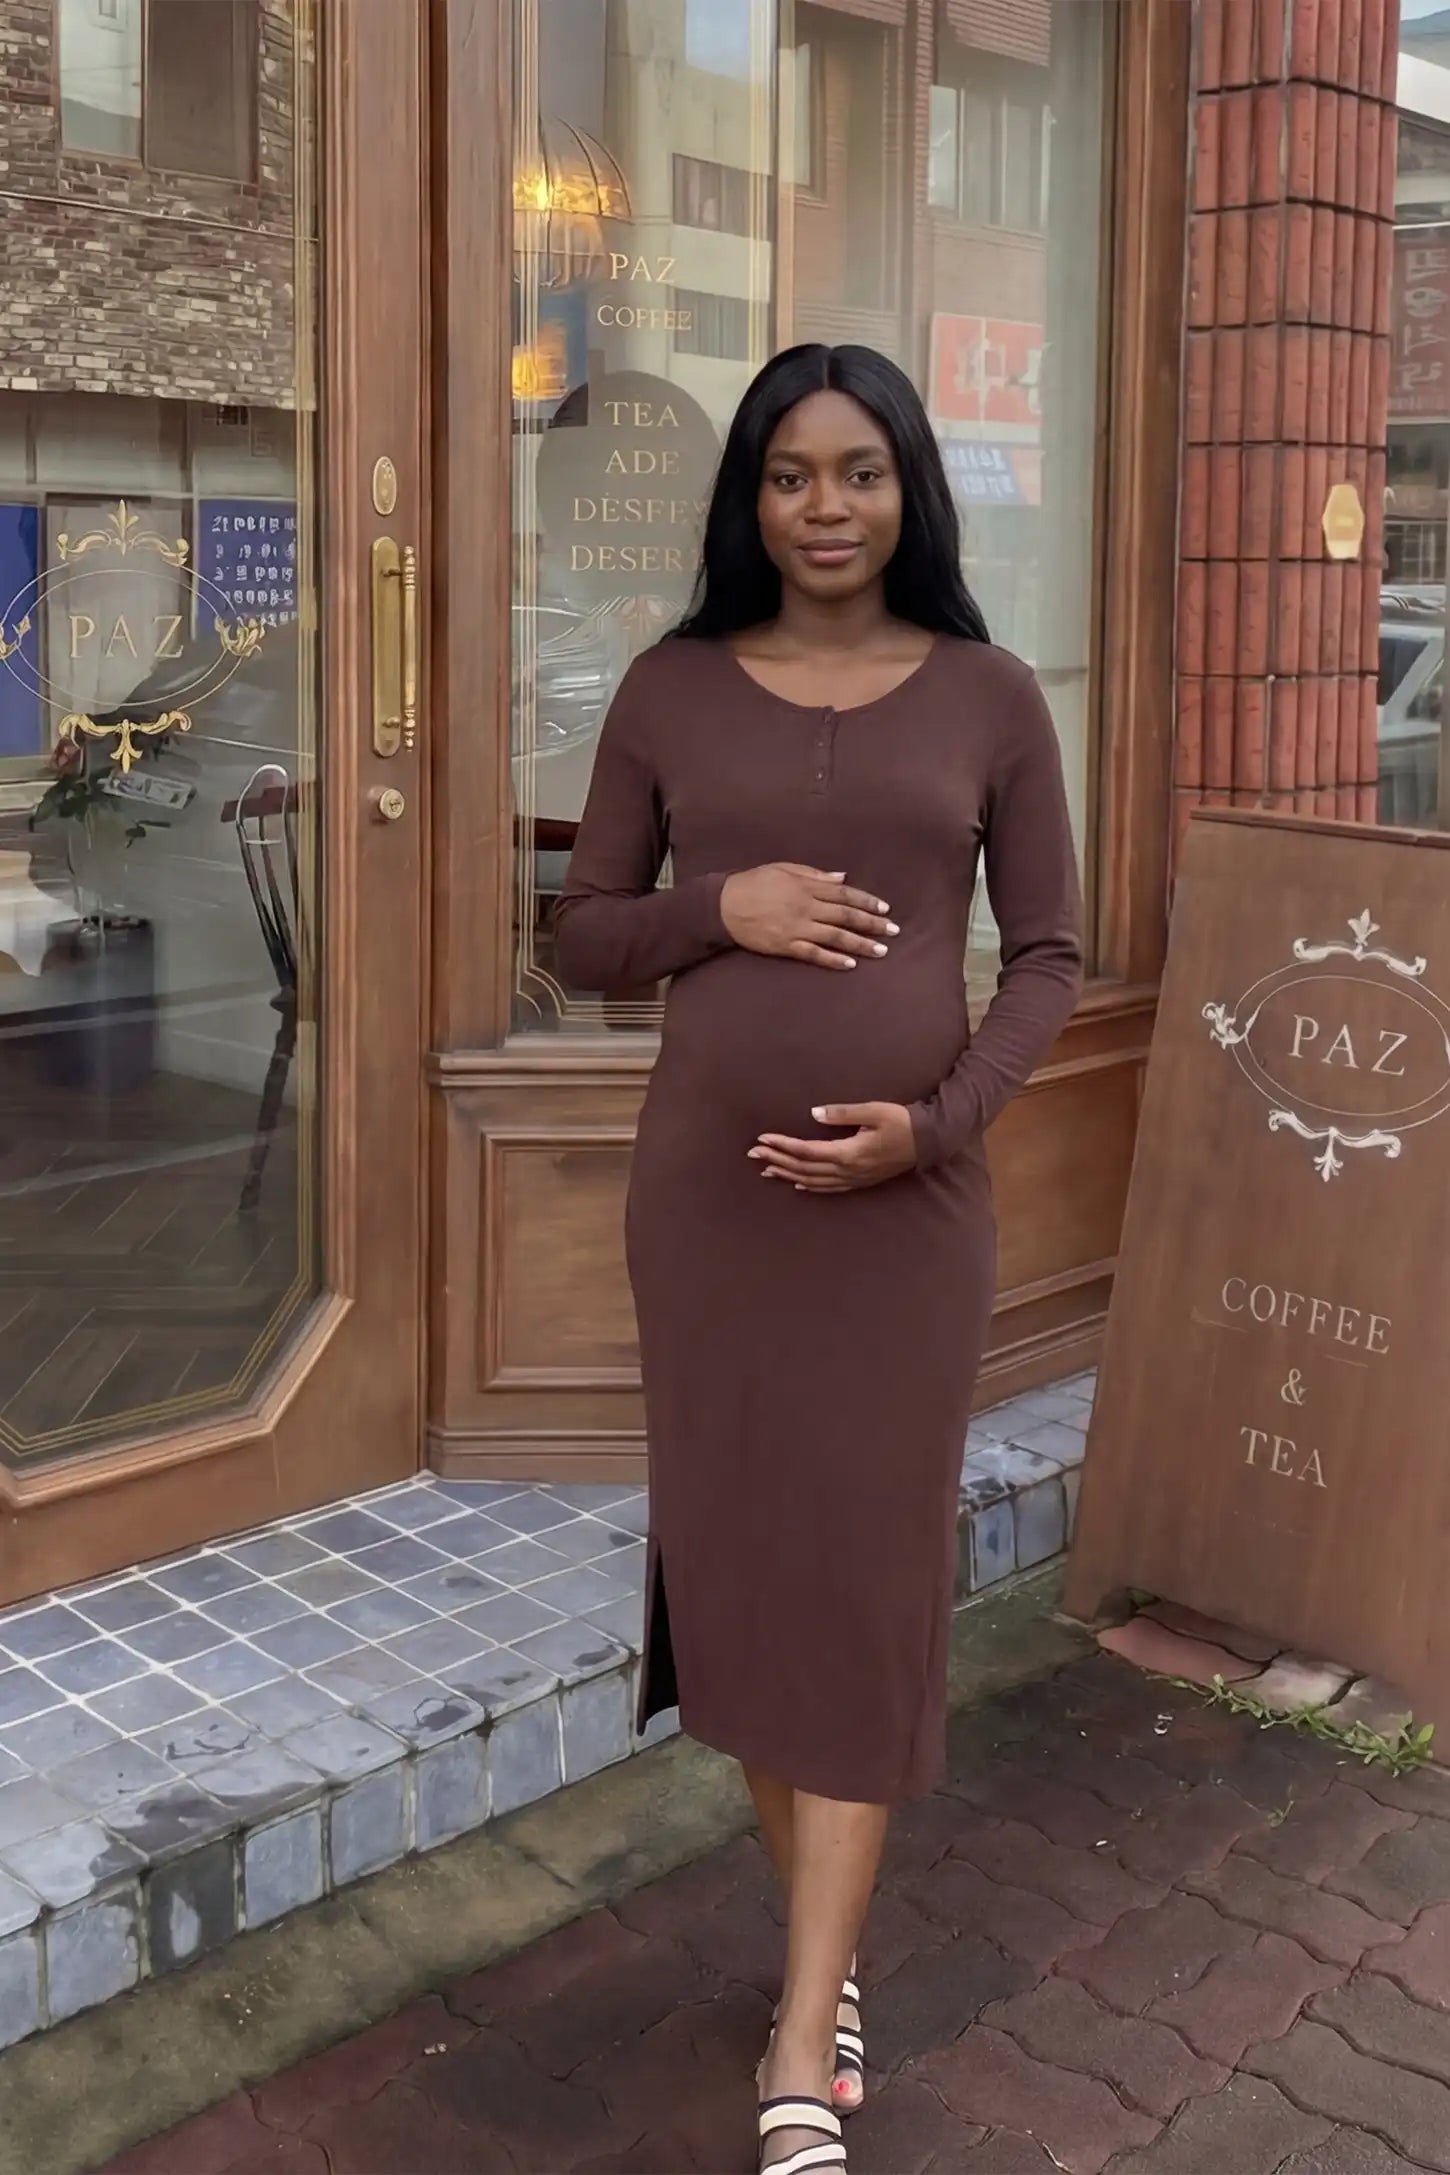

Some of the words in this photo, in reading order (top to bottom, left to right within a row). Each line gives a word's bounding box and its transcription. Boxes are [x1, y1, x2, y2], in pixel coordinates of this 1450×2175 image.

[609, 253, 676, 283] PAZ
[604, 401, 679, 428] TEA
[604, 449, 680, 475] ADE
[69, 615, 184, 659] PAZ
[1288, 1014, 1408, 1076] PAZ
[1221, 1277, 1392, 1354] COFFEE
[1280, 1368, 1308, 1406] &
[1240, 1426, 1327, 1488] TEA
